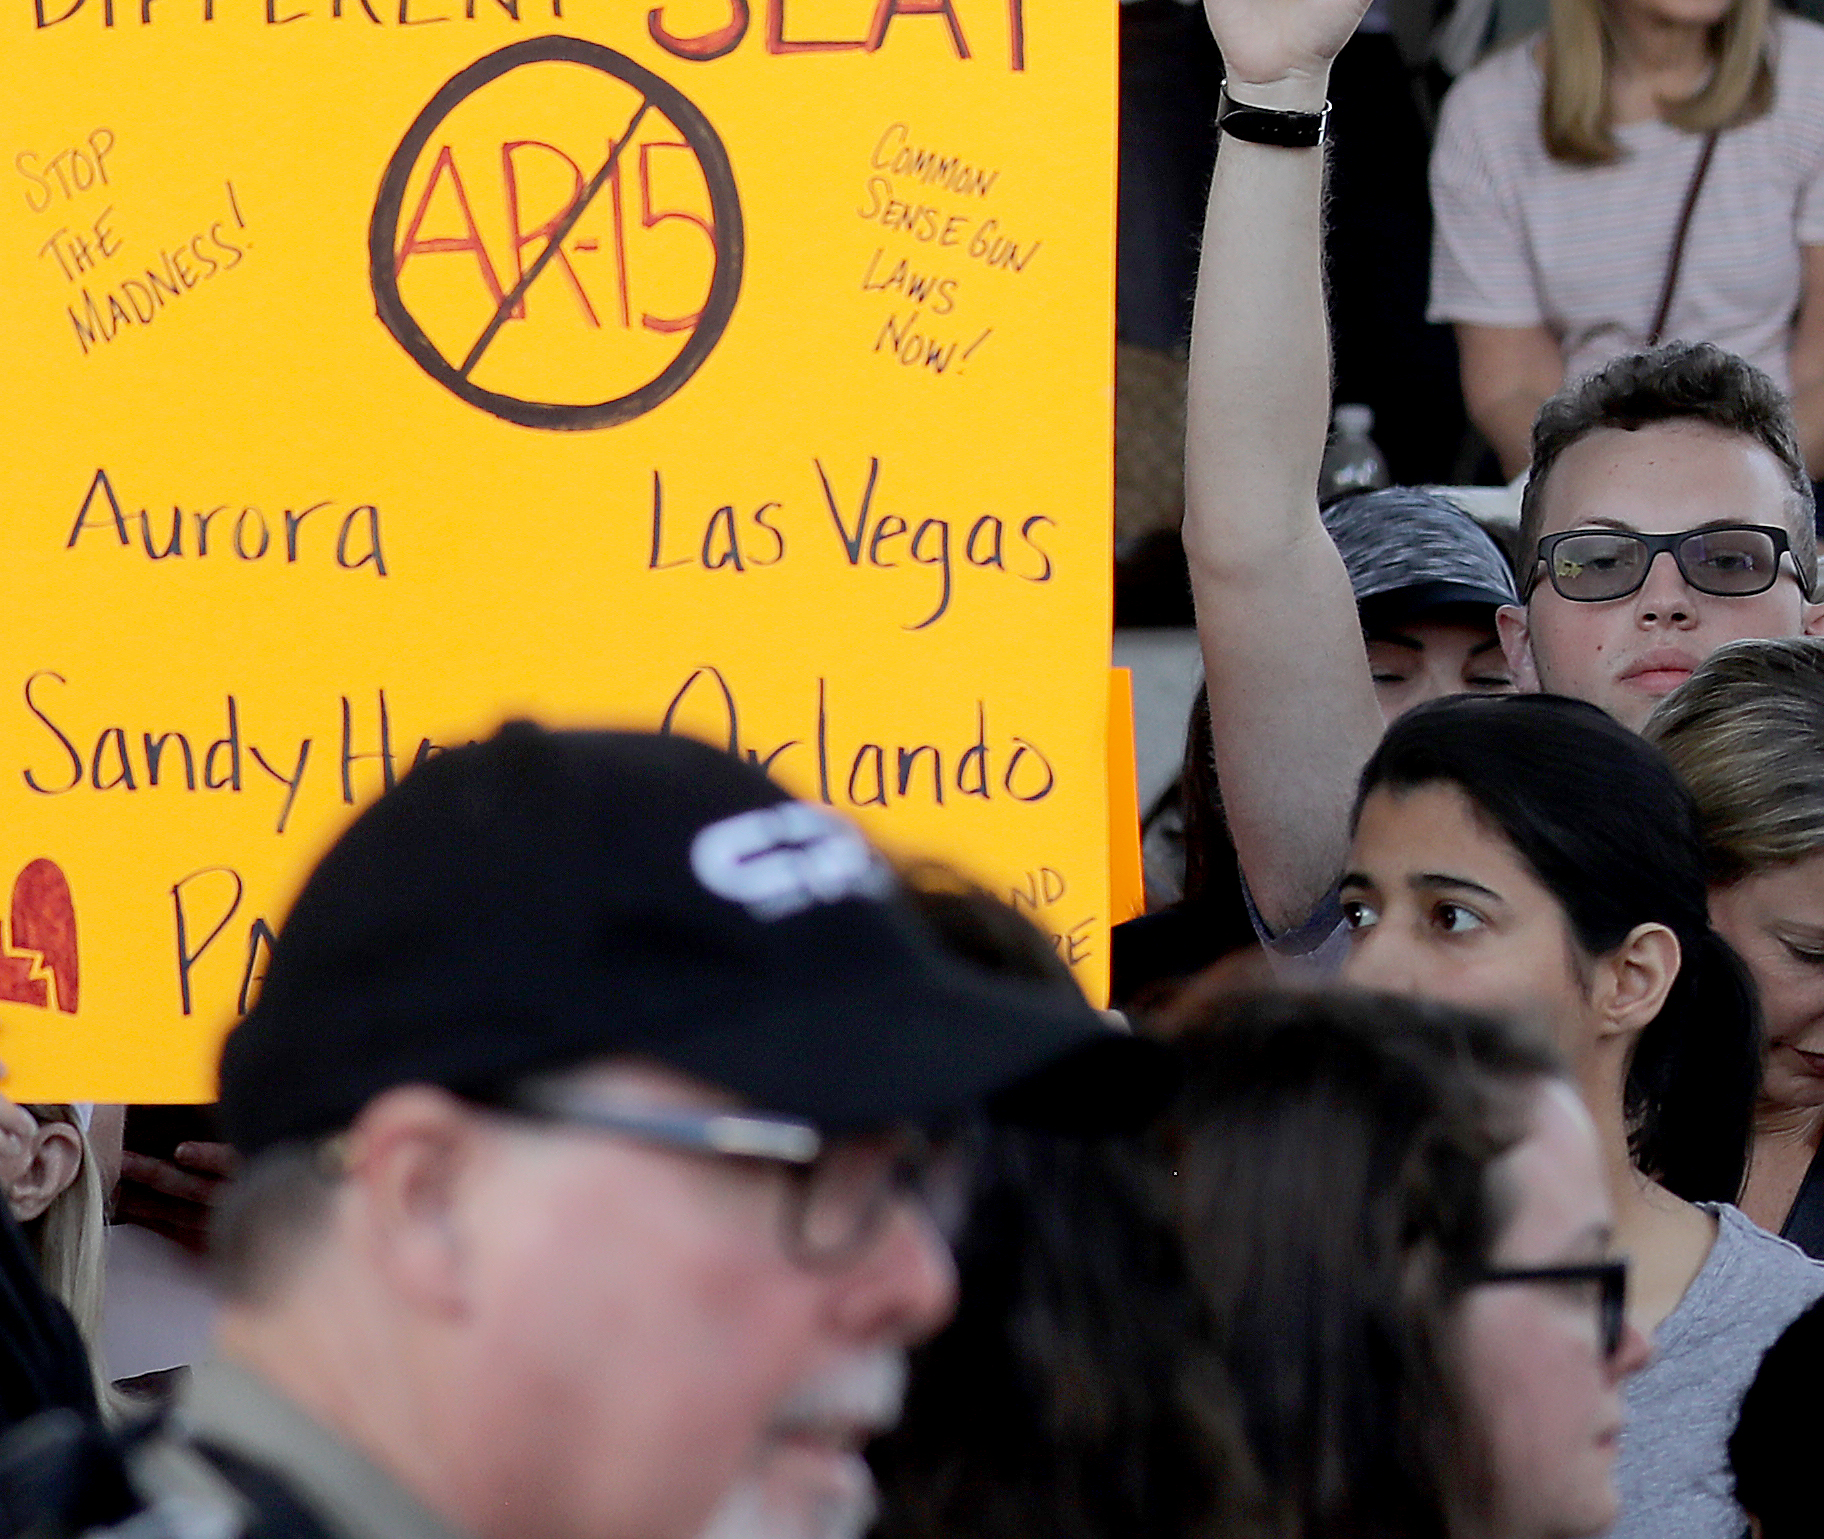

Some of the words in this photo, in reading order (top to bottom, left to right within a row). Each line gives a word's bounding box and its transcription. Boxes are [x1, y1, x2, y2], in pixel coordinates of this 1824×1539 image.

[15, 127, 115, 213] STOP
[38, 205, 124, 282] THE
[66, 180, 254, 356] MADNESS!
[394, 139, 718, 333] AR-15
[857, 178, 968, 247] SENSE
[968, 218, 1041, 274] GUN
[860, 249, 959, 316] LAWS
[66, 468, 388, 577] Aurora
[649, 468, 784, 574] Las
[814, 456, 1057, 630] Vegas
[22, 670, 311, 833] Sandy
